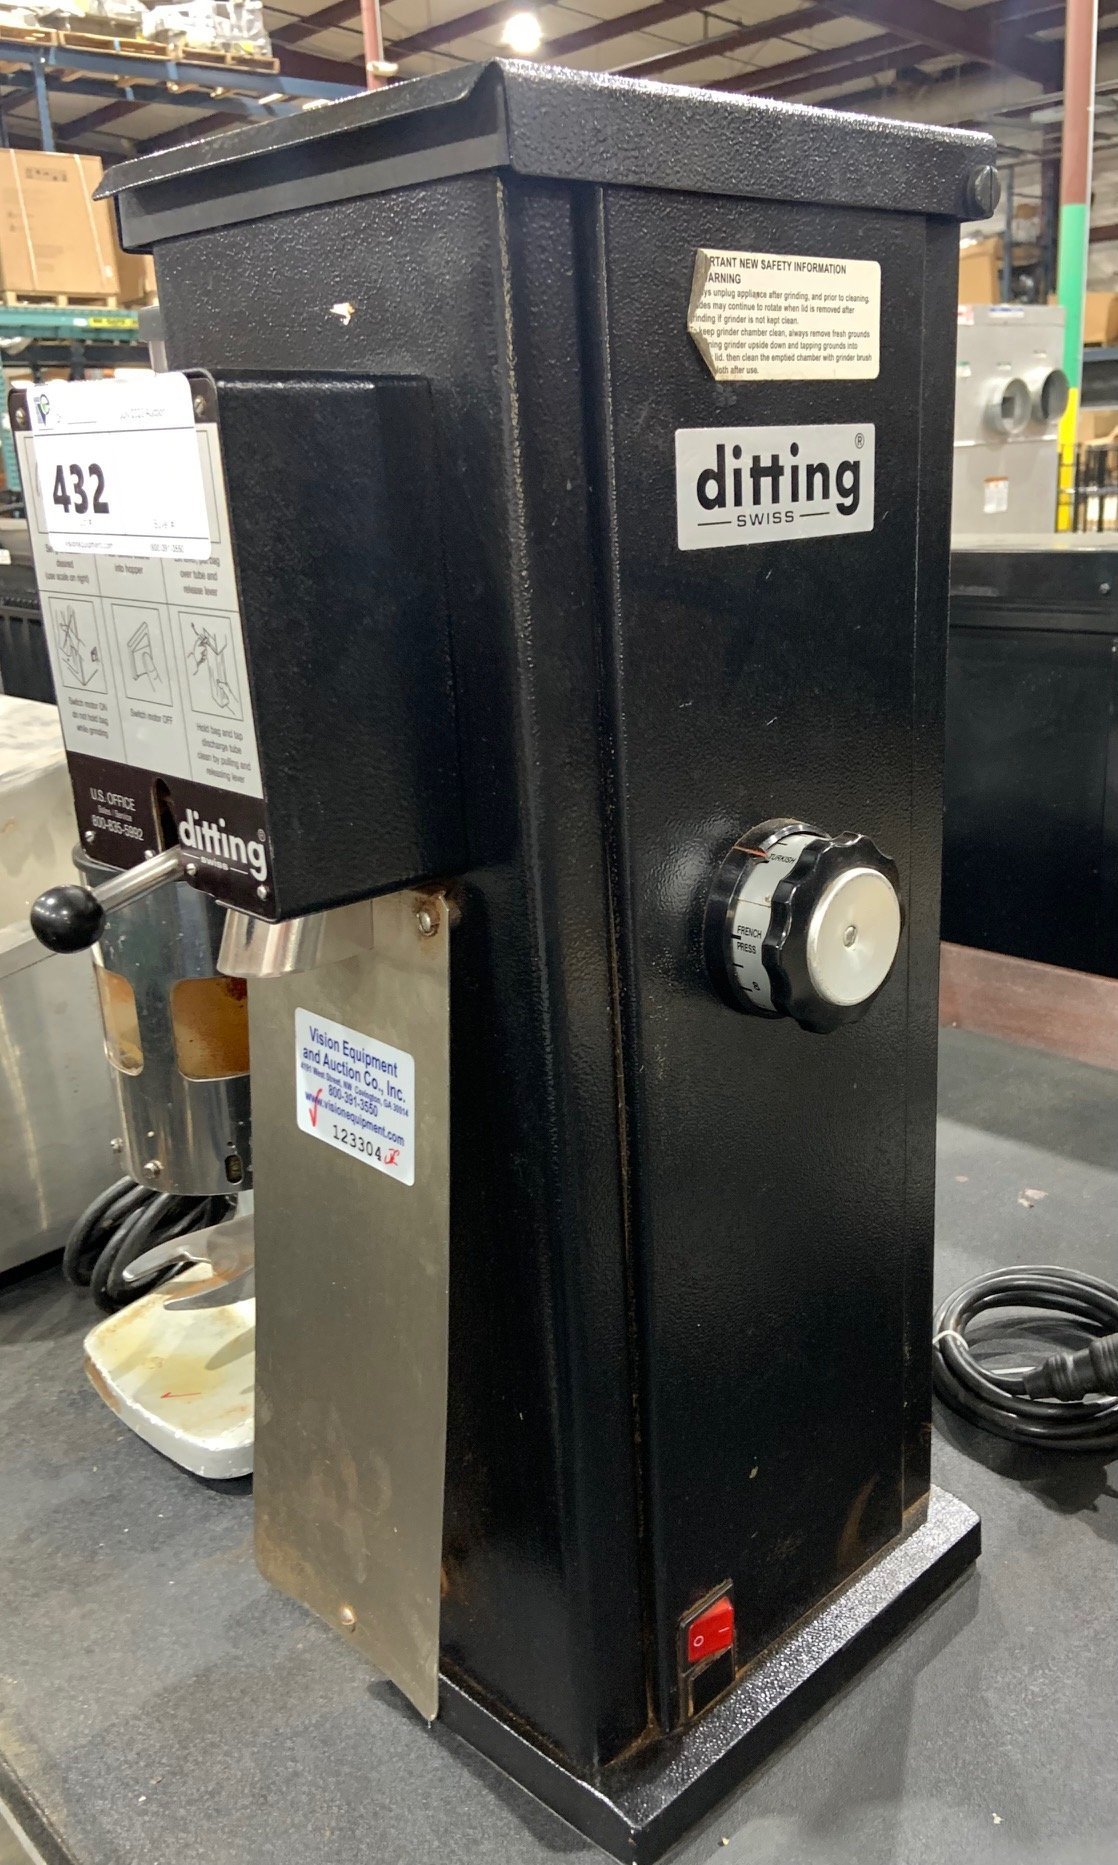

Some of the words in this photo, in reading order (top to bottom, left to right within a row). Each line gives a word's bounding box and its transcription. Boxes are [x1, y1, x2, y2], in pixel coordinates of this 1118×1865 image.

[740, 259, 759, 270] NEW
[761, 259, 792, 271] SAFETY
[794, 261, 846, 274] INFORMATION
[713, 289, 735, 300] unplug
[769, 290, 783, 299] after
[811, 293, 822, 301] and
[824, 293, 837, 303] prior
[838, 294, 845, 302] to
[712, 302, 726, 312] may
[728, 301, 755, 311] continue
[756, 302, 763, 311] to
[764, 302, 782, 312] rotate
[784, 304, 799, 313] when
[800, 304, 809, 313] lid
[816, 305, 841, 314] removed
[842, 306, 855, 315] after
[724, 314, 746, 324] grinder
[767, 316, 780, 326] kept
[716, 328, 739, 338] grinder
[740, 328, 767, 337] chamber
[789, 329, 808, 339] always
[809, 330, 830, 338] remove
[832, 329, 846, 338] fresh
[848, 330, 871, 340] grounds
[724, 341, 746, 351] grinder
[748, 341, 768, 351] upside
[770, 341, 786, 349] down
[788, 342, 798, 350] and
[800, 342, 821, 351] tapping
[822, 342, 846, 351] grounds
[847, 342, 858, 350] into
[726, 352, 740, 361] then
[741, 353, 759, 362] clean
[760, 353, 770, 362] the
[771, 354, 795, 364] emptied
[796, 353, 821, 362] chamber
[822, 353, 834, 362] with
[835, 354, 855, 364] grinder
[857, 353, 872, 362] brush
[730, 366, 745, 375] after
[696, 442, 860, 516] ditting
[53, 463, 110, 514] 432
[737, 510, 795, 527] SWISS
[107, 791, 136, 811] OFFICE
[179, 808, 267, 881] ditting
[769, 853, 795, 864] TURKISH
[737, 925, 762, 939] FRENCH
[737, 941, 756, 954] PRESS
[309, 1026, 340, 1052] Vision
[343, 1040, 398, 1078] Equipment
[303, 1047, 320, 1064] and
[323, 1053, 361, 1083] Auction
[364, 1070, 384, 1096] Co.,
[387, 1080, 406, 1103] Inc.
[328, 1083, 378, 1117] 800-391-3550
[305, 1091, 405, 1147] www.visionequipment.com
[333, 1124, 382, 1162] 123304
